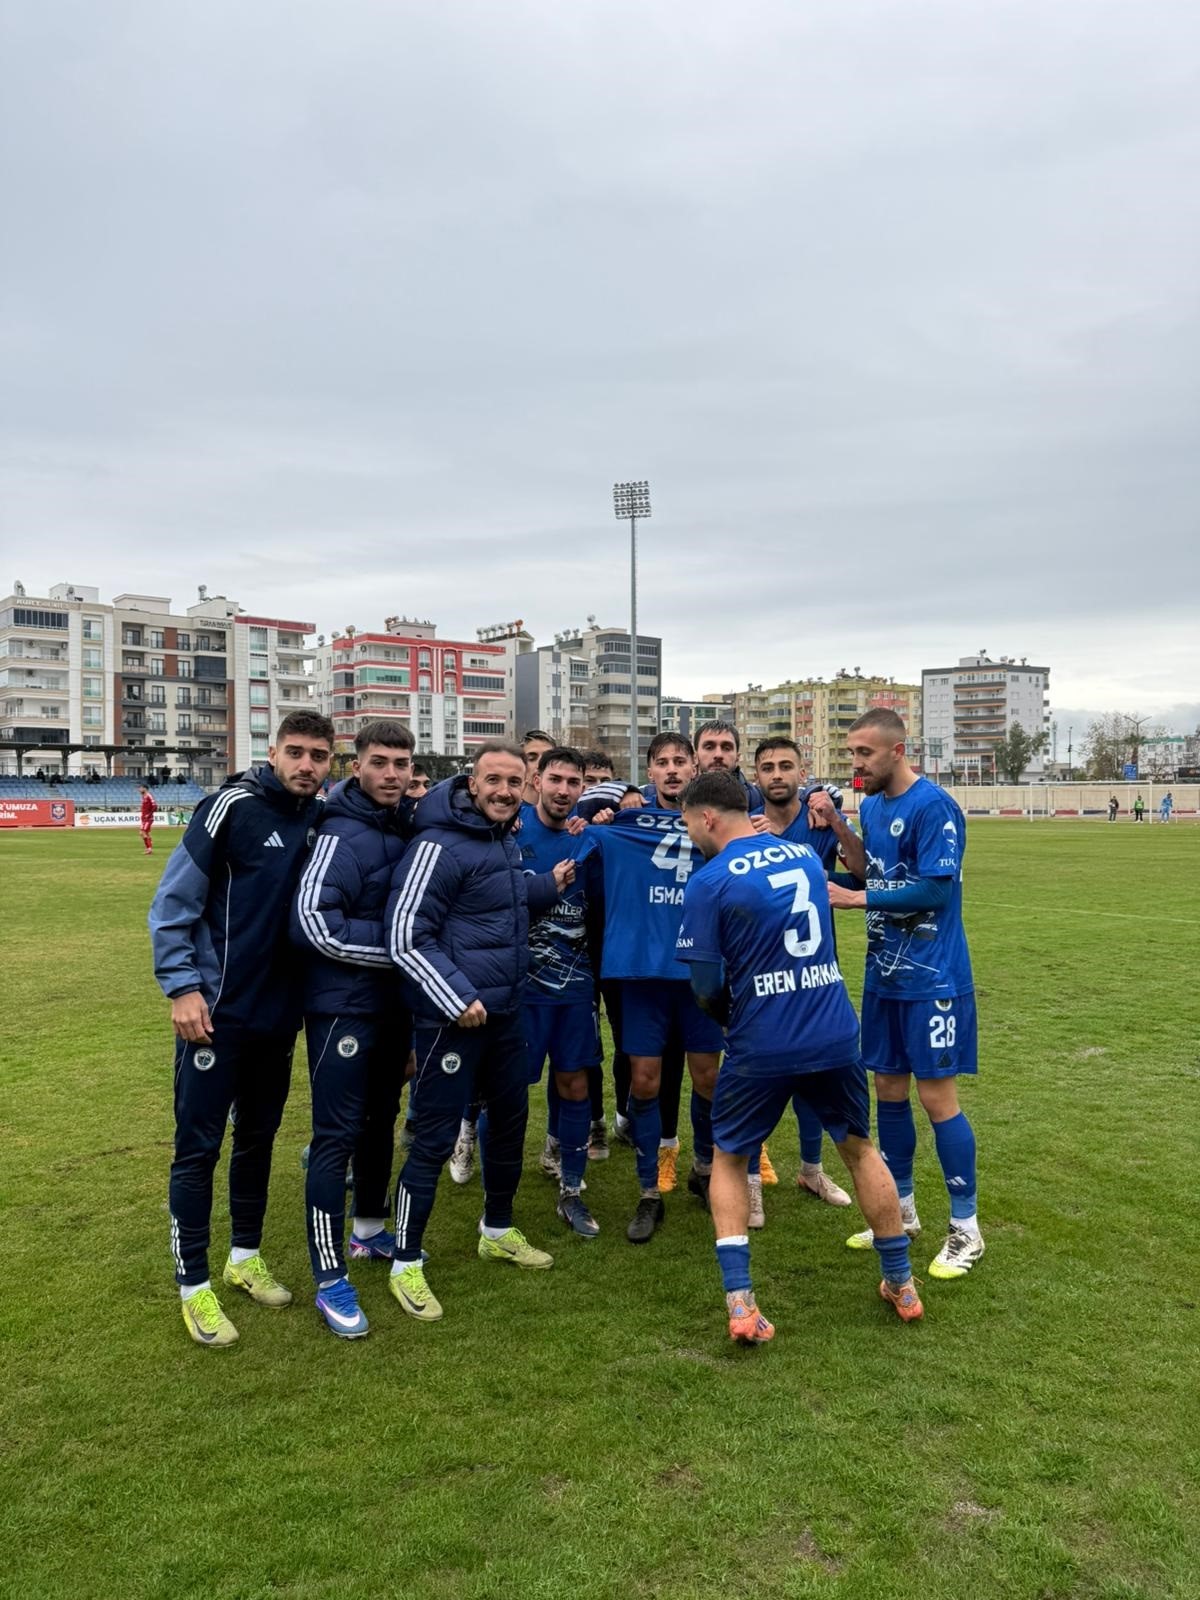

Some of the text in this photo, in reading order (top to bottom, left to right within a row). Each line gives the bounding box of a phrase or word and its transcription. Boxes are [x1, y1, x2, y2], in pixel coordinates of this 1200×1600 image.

[94, 816, 116, 824] UÇAK
[650, 832, 693, 883] 4
[767, 867, 823, 958] 3
[676, 937, 694, 948] SAN
[753, 969, 797, 997] EREN
[929, 1014, 956, 1049] 28
